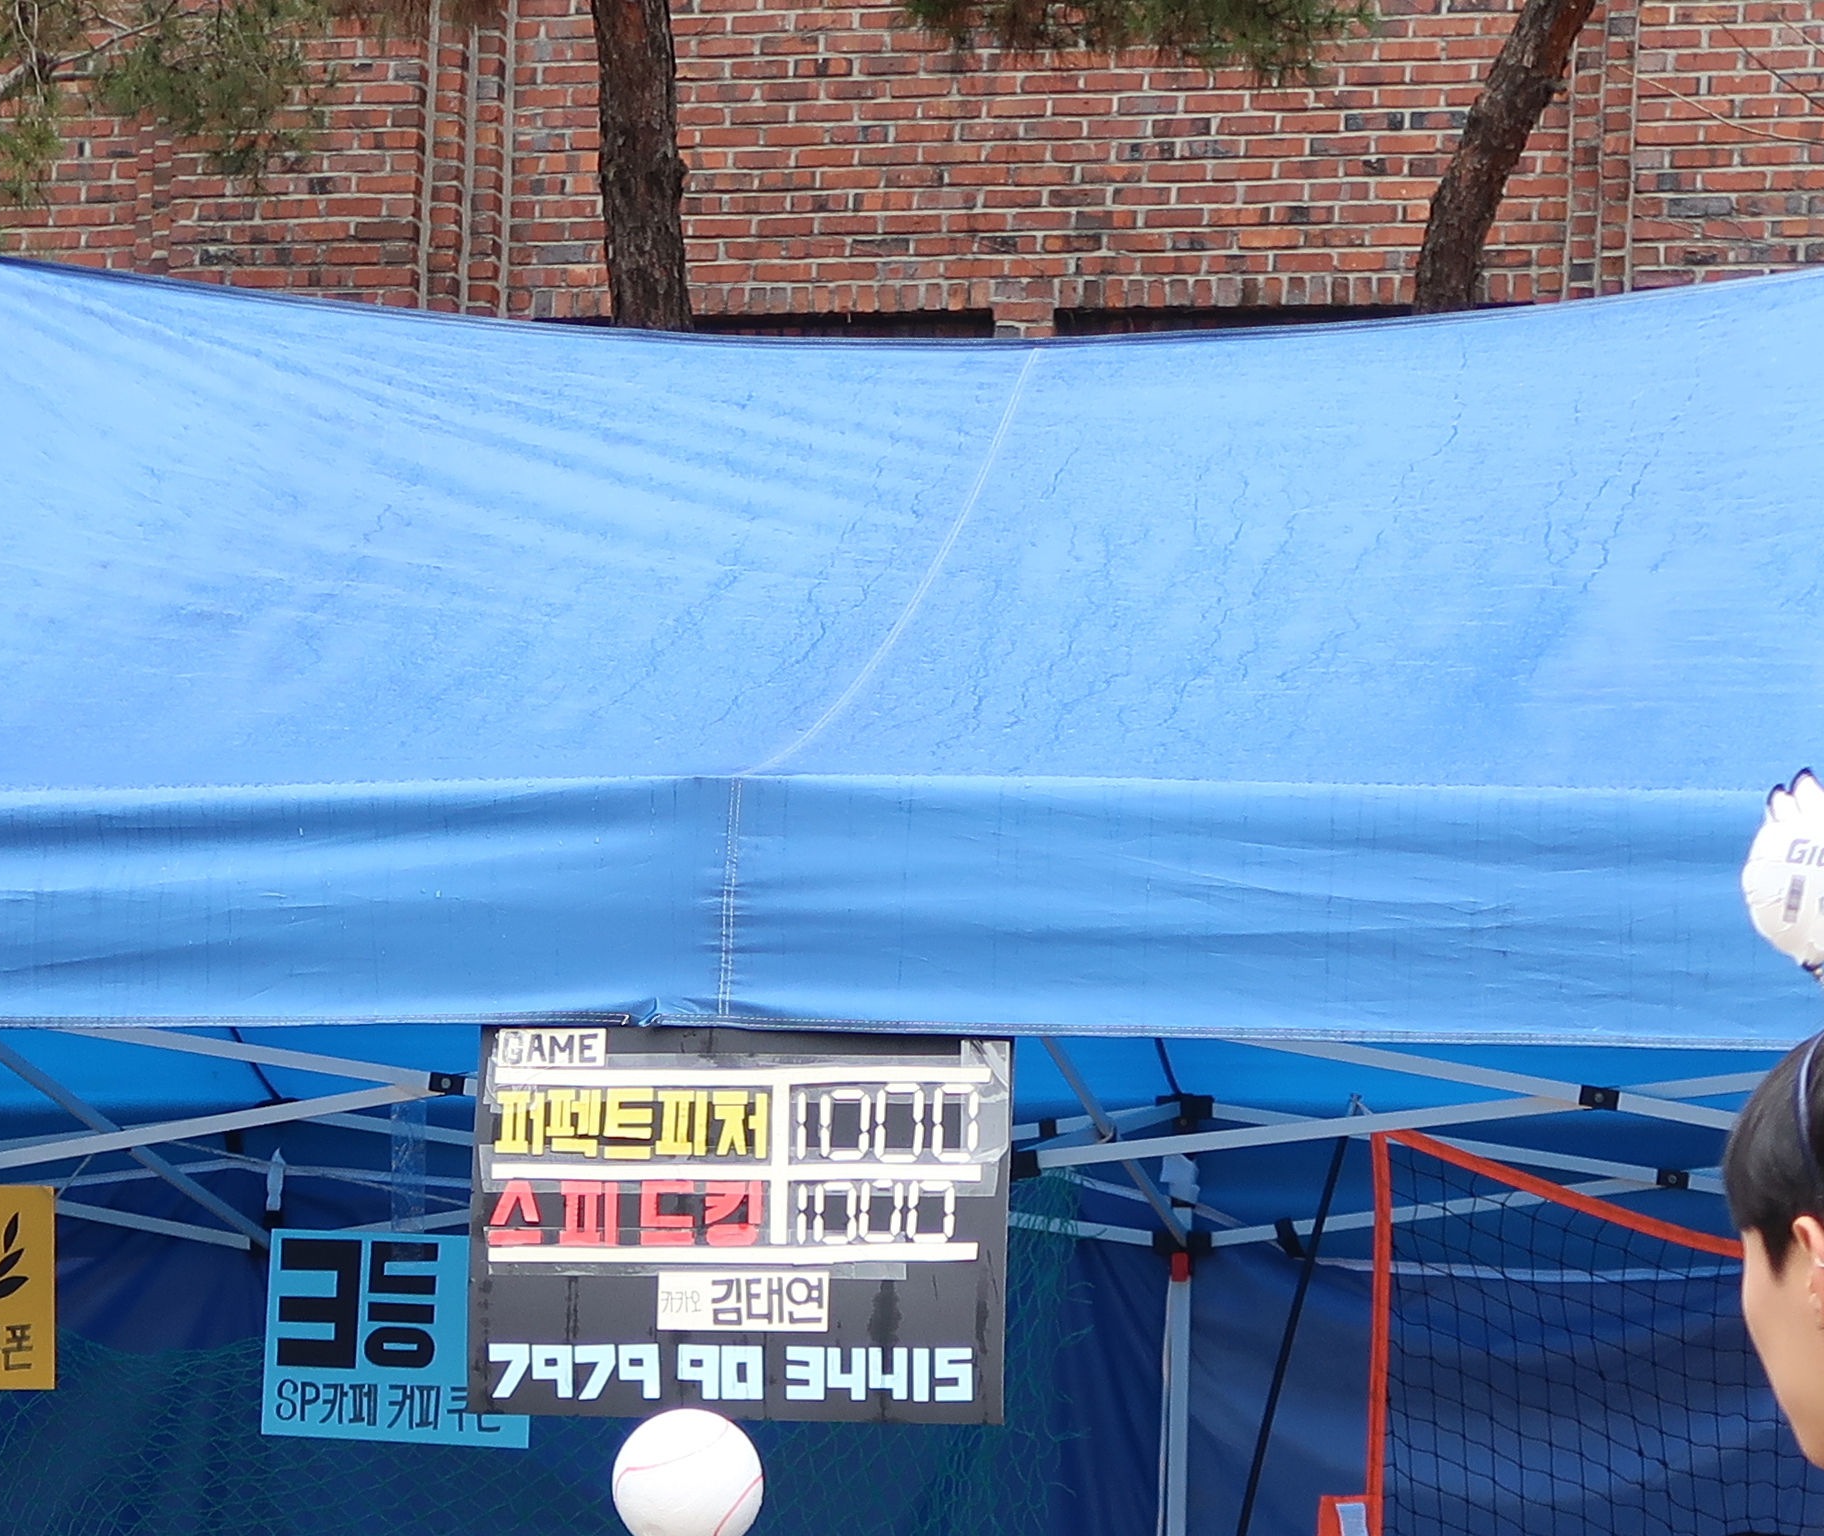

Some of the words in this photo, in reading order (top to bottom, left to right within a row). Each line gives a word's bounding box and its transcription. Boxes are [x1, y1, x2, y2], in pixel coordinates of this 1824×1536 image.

[500, 1030, 600, 1064] GAME
[796, 1082, 979, 1163] 1000
[487, 1180, 763, 1247] 스피드킹
[796, 1178, 956, 1244] 1000
[276, 1238, 439, 1369] 3등
[660, 1290, 703, 1313] 카카오
[710, 1277, 824, 1326] 김태연
[276, 1379, 378, 1426] SP카페
[487, 1343, 661, 1399] 7979
[677, 1344, 764, 1400] 90
[785, 1345, 974, 1401] 34415
